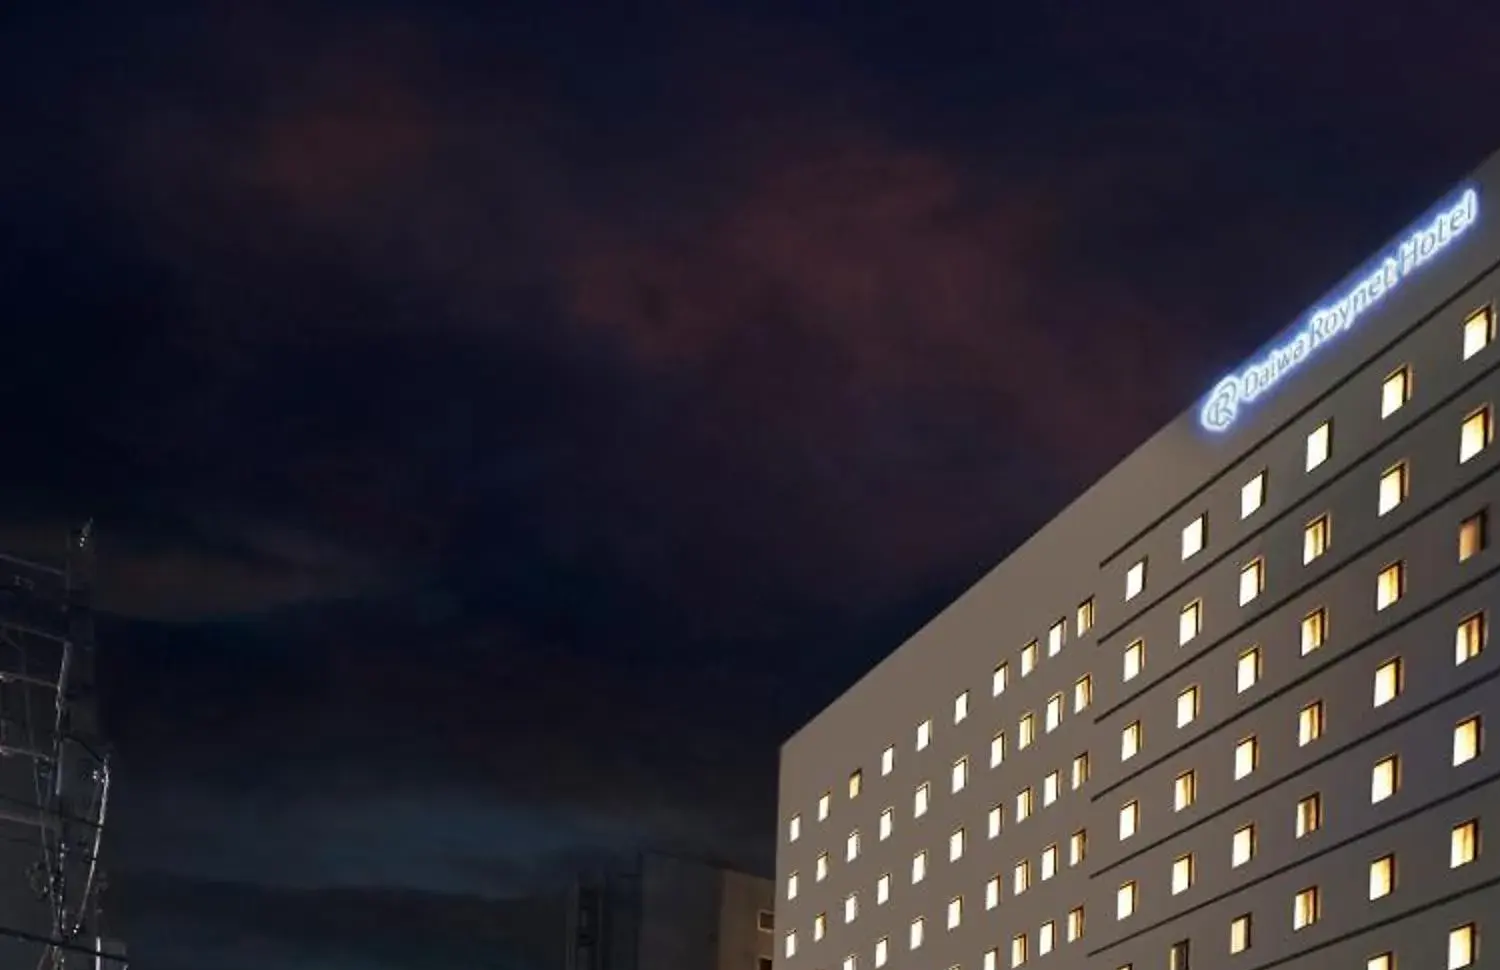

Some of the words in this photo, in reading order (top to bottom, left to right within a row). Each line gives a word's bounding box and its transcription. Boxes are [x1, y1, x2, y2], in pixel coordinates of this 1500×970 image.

[1244, 340, 1306, 397] Daiwa
[1309, 262, 1396, 349] Roynet
[1400, 192, 1475, 273] Hotel
